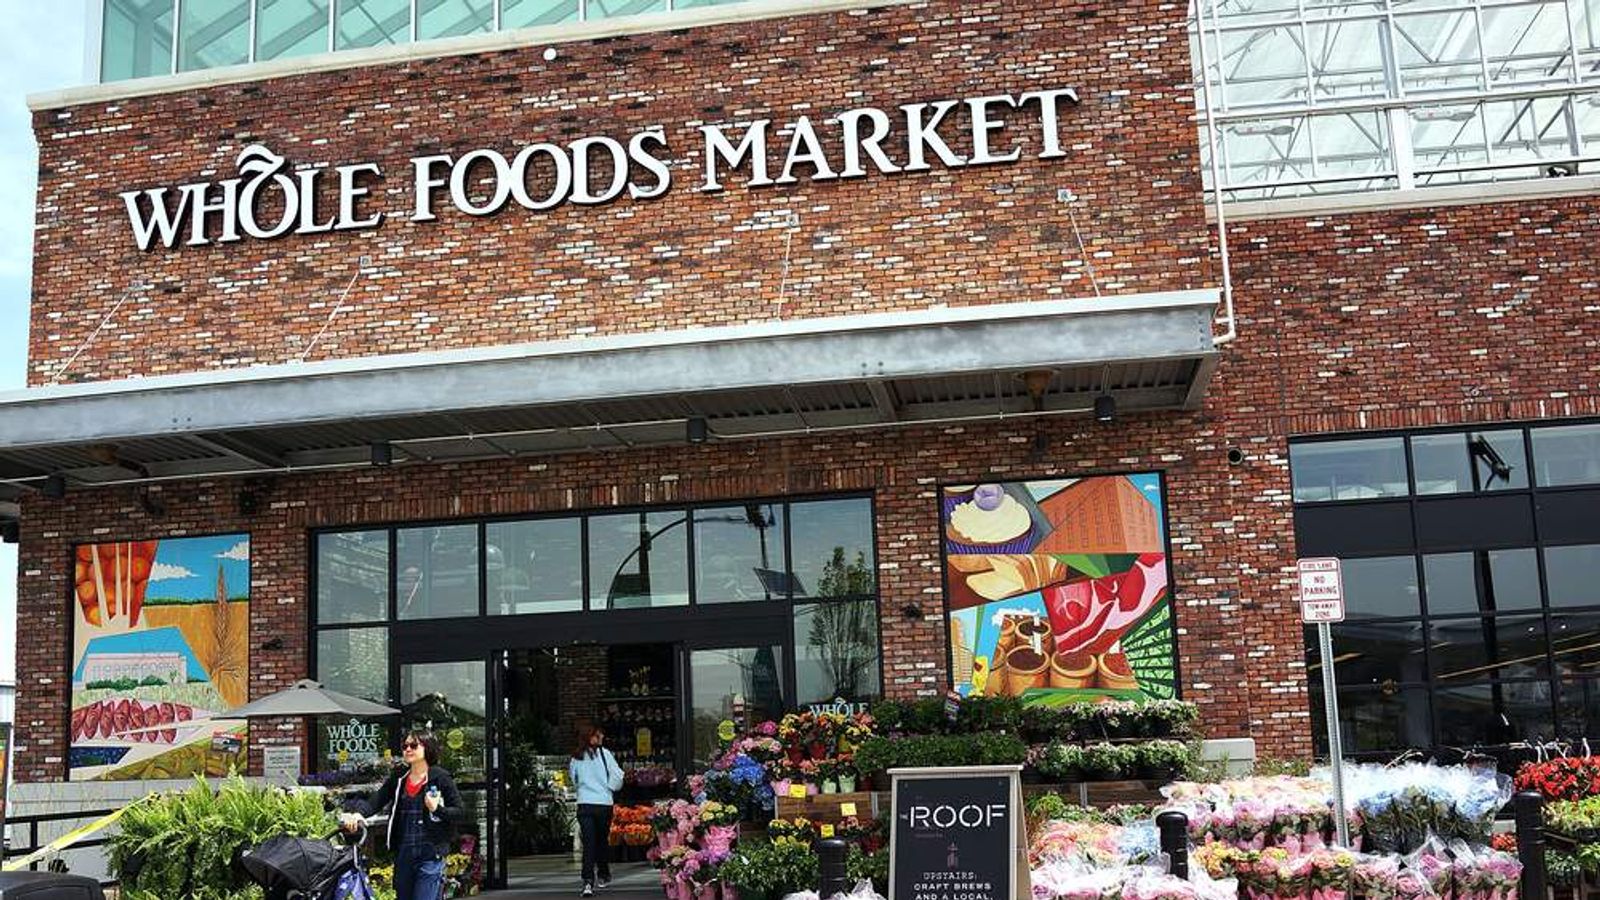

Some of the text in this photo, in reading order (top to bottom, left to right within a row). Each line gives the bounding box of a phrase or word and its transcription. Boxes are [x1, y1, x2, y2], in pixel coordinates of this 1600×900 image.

[118, 87, 1079, 251] WHOLE FOODS MARKET
[1314, 576, 1325, 584] NO
[1304, 585, 1337, 596] PARKING
[326, 718, 380, 738] WHOLE
[329, 738, 378, 753] FOODS
[910, 804, 1006, 828] ROOF
[913, 883, 949, 891] CRAFT
